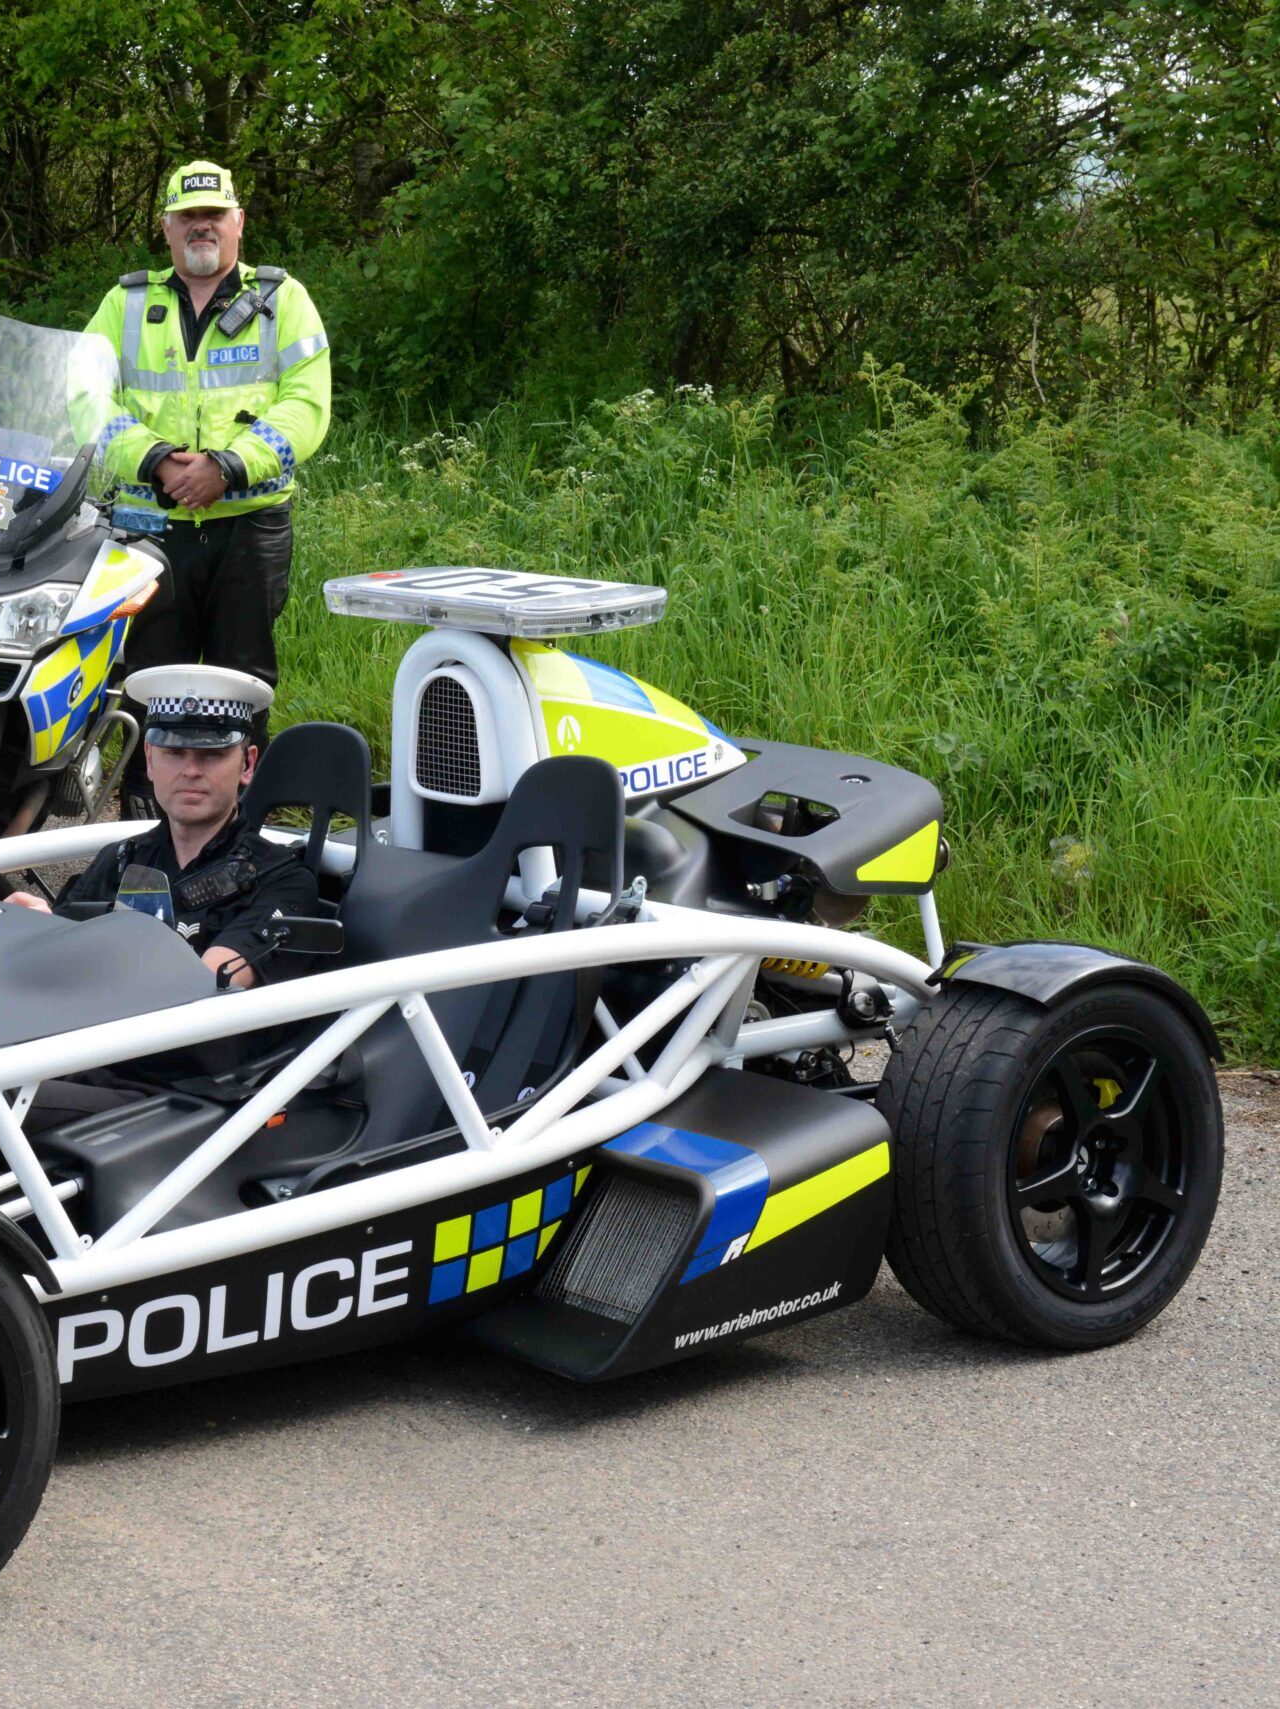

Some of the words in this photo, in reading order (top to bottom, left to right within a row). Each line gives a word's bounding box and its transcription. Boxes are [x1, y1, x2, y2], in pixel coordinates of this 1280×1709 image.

[184, 176, 218, 189] POLICE
[210, 347, 257, 363] POLICE
[57, 1240, 413, 1384] POLICE
[674, 1281, 842, 1349] www.arielmotor.co.uk
